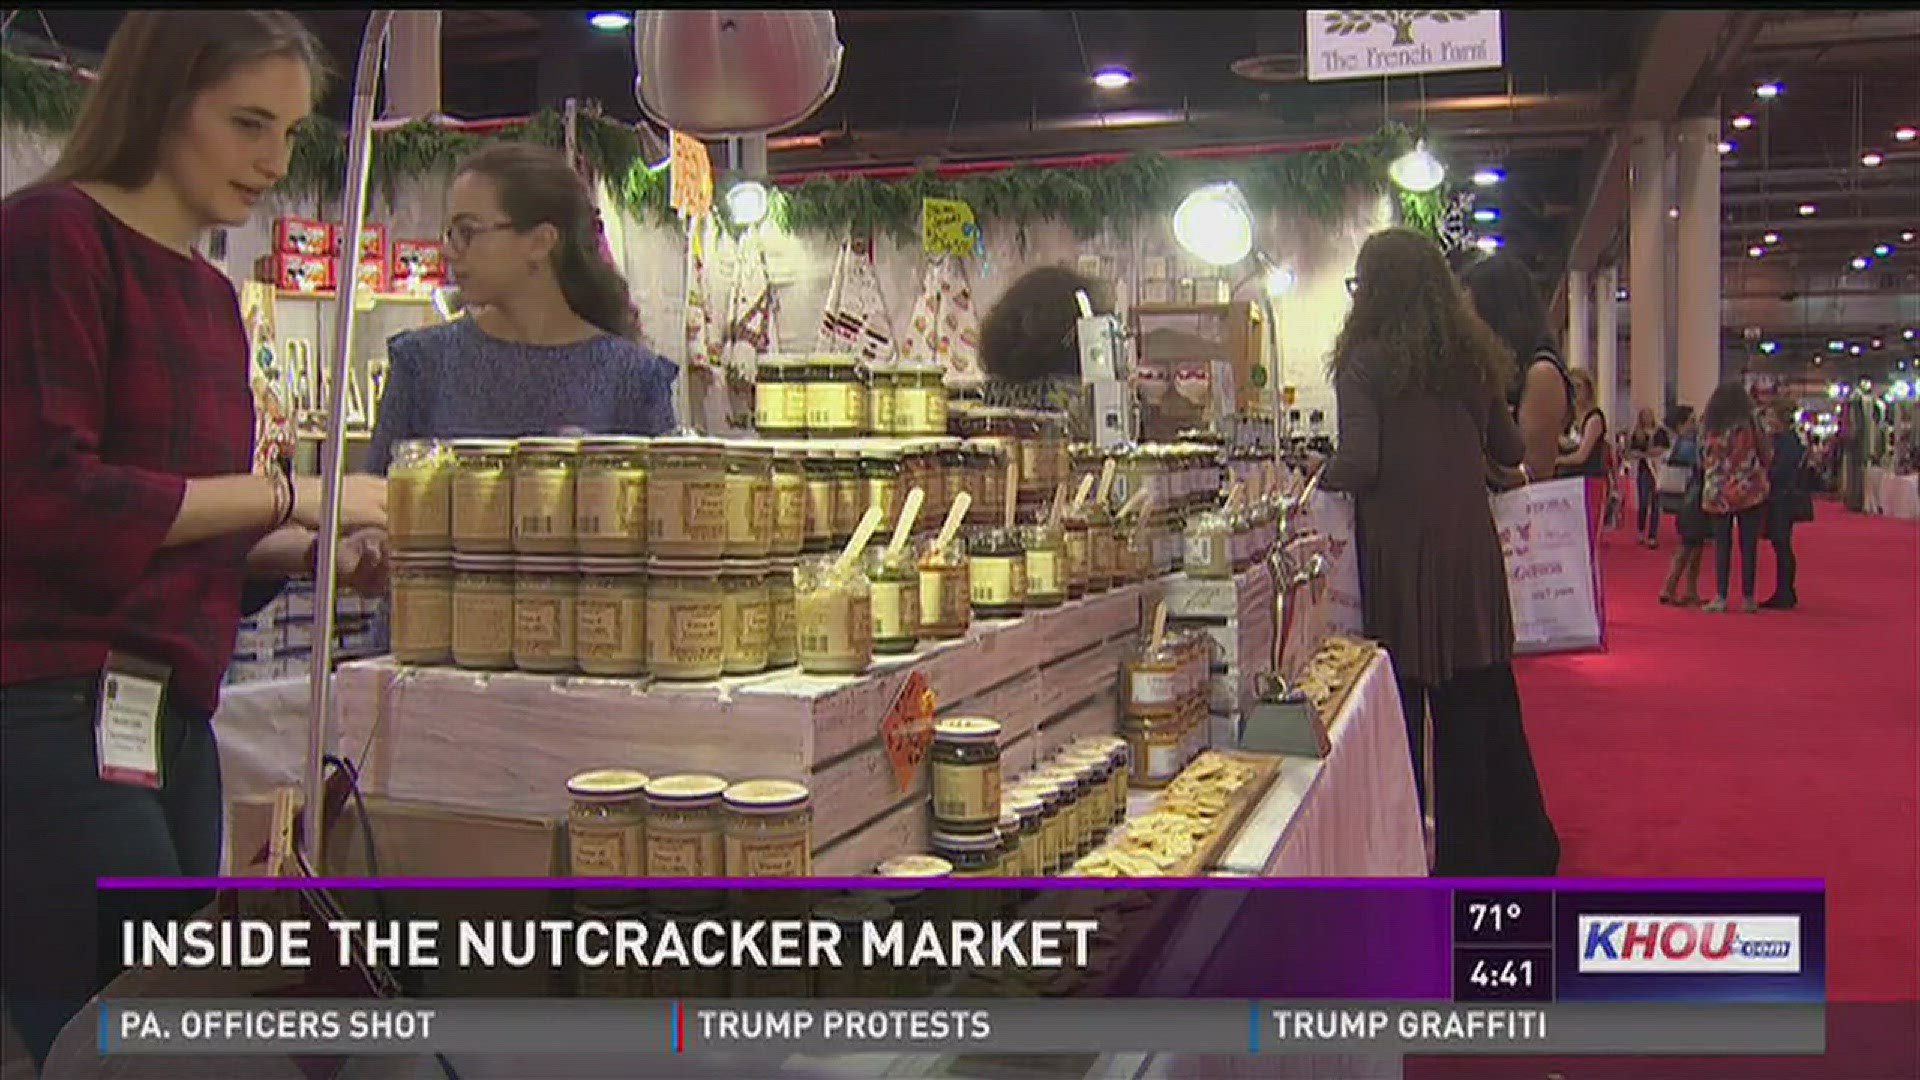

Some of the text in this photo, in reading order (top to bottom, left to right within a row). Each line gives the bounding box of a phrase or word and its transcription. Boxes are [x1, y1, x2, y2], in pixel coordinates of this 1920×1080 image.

[1321, 39, 1488, 72] The French Farm
